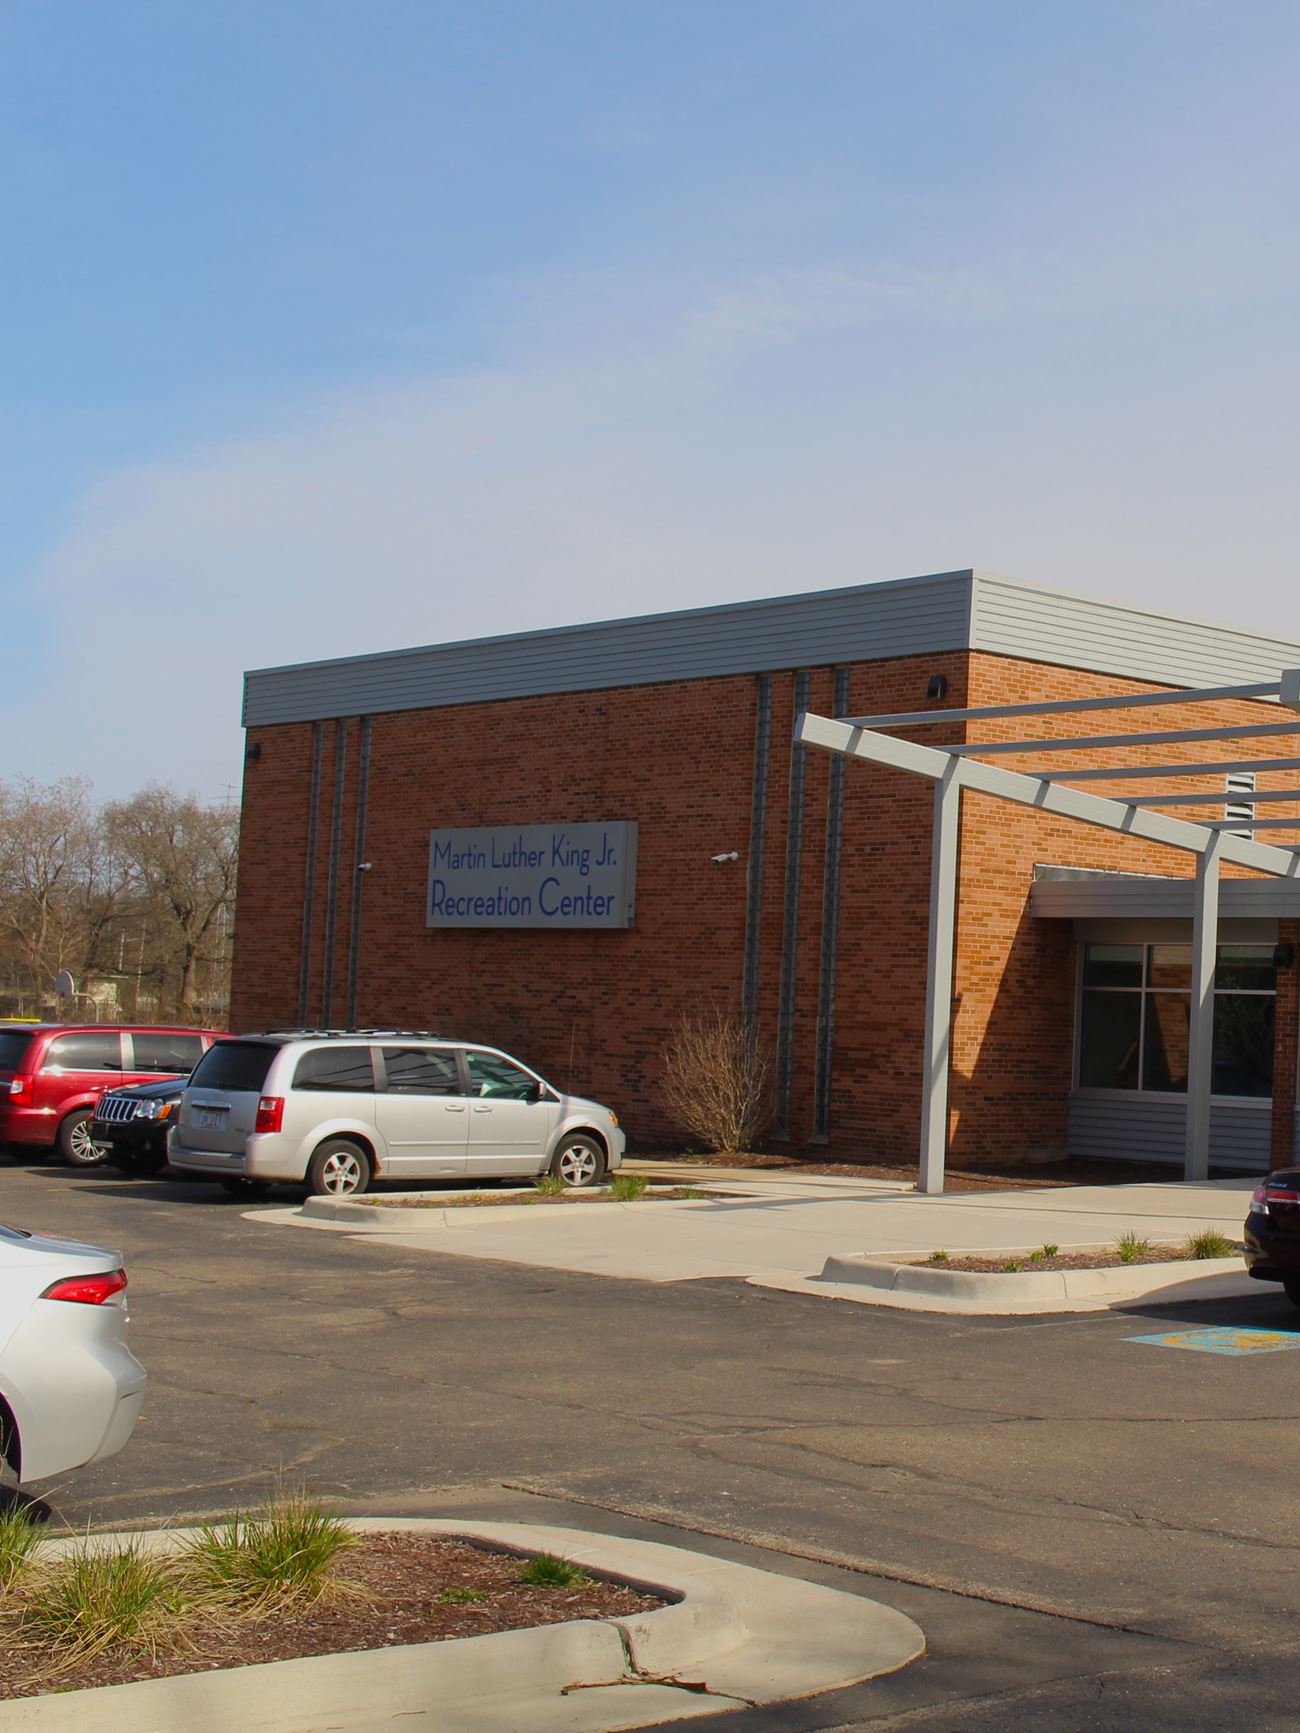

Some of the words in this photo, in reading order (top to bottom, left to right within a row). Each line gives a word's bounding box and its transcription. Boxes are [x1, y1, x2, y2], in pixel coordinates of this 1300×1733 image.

[433, 840, 486, 870] Martin
[492, 834, 545, 868] Luther
[552, 833, 590, 876] King
[595, 832, 617, 866] Jr.
[431, 879, 531, 916] Recreation
[539, 877, 615, 916] Center
